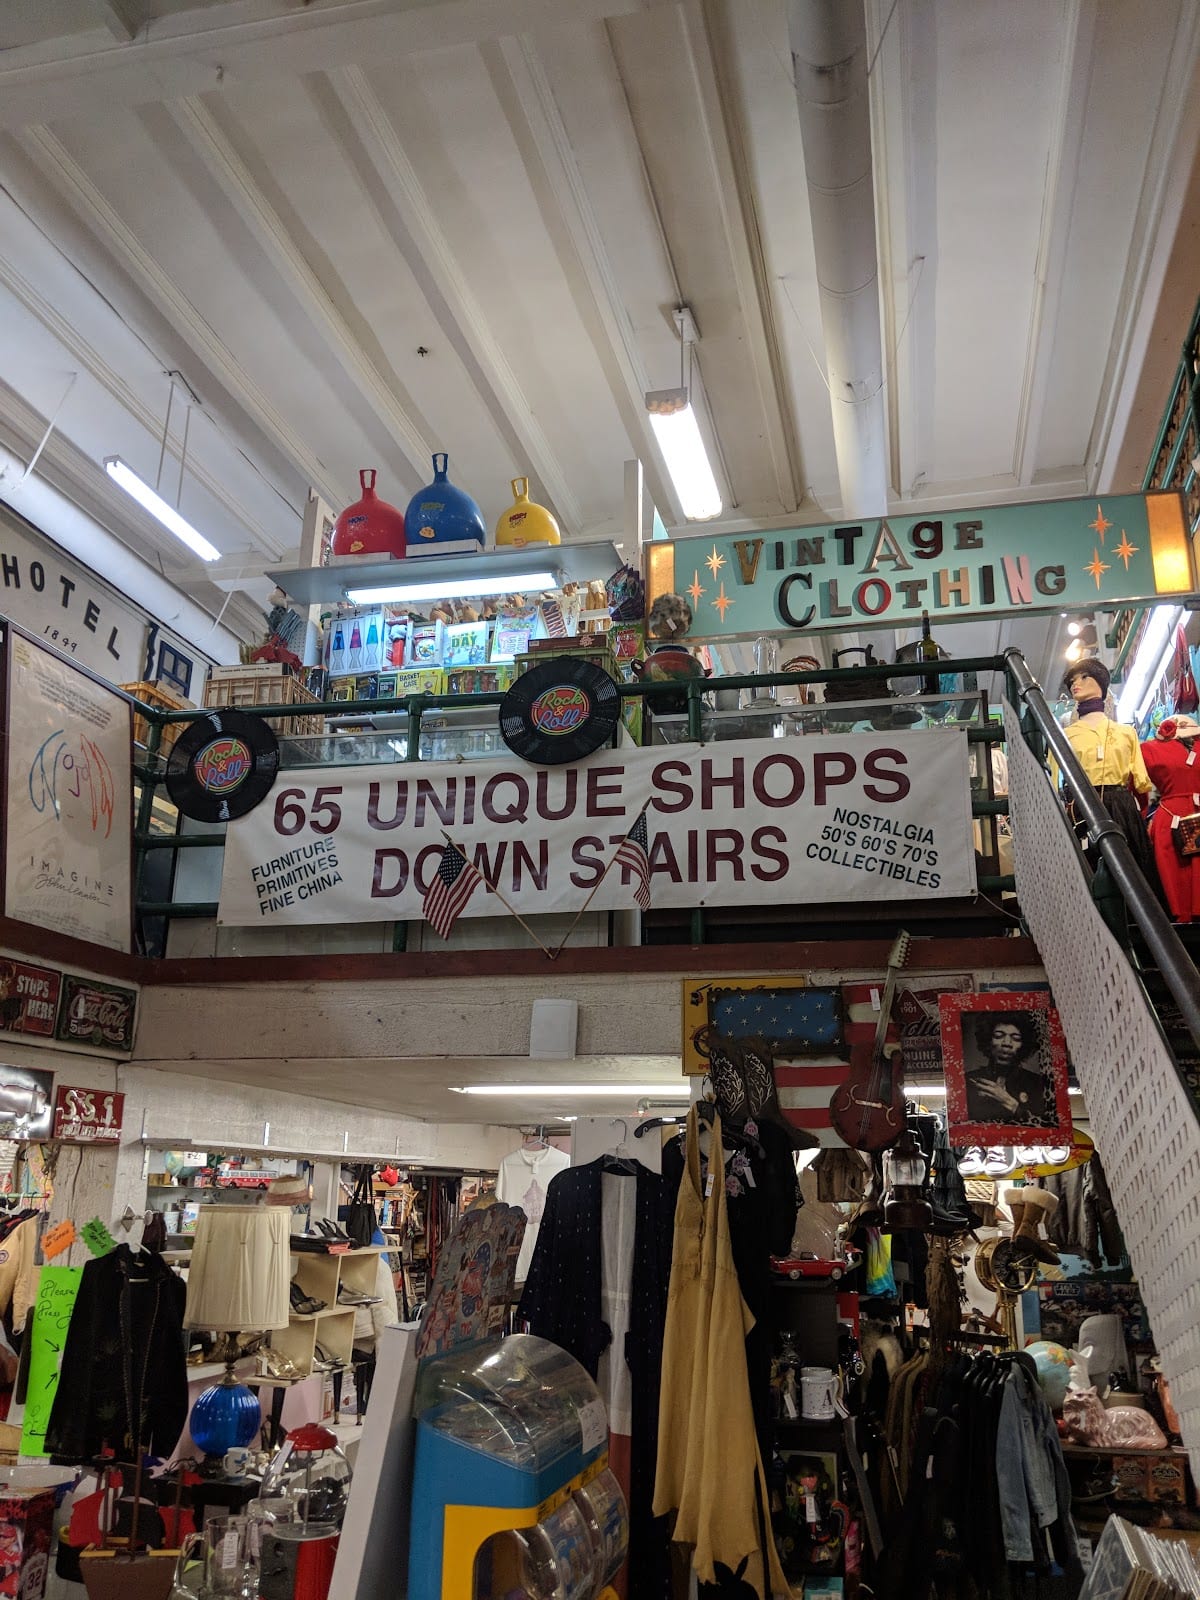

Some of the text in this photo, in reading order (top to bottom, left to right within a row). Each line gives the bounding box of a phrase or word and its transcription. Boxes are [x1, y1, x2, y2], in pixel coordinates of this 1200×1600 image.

[1, 553, 120, 660] HOTEL
[777, 554, 1066, 628] CLOTHING
[541, 688, 583, 709] Rock
[554, 706, 563, 716] &
[537, 709, 580, 730] Roll
[204, 738, 242, 768] Rock
[218, 761, 227, 772] &
[205, 760, 242, 790] Roll
[273, 748, 911, 835] 65 UNIQUE SHOPS
[821, 825, 939, 866] 50'S 60'S 70'S
[832, 807, 935, 845] NOSTALGIA
[30, 856, 114, 896] IMAGINE
[251, 837, 337, 882] FURNITURE
[256, 854, 339, 898] PRIMITIVES
[370, 825, 790, 898] DOWN STAIRS
[806, 843, 941, 889] COLLECTIBLES
[259, 871, 344, 916] FINE CHINA
[16, 975, 50, 999] STOPS
[27, 998, 55, 1020] HERE
[1055, 1288, 1080, 1296] WARS
